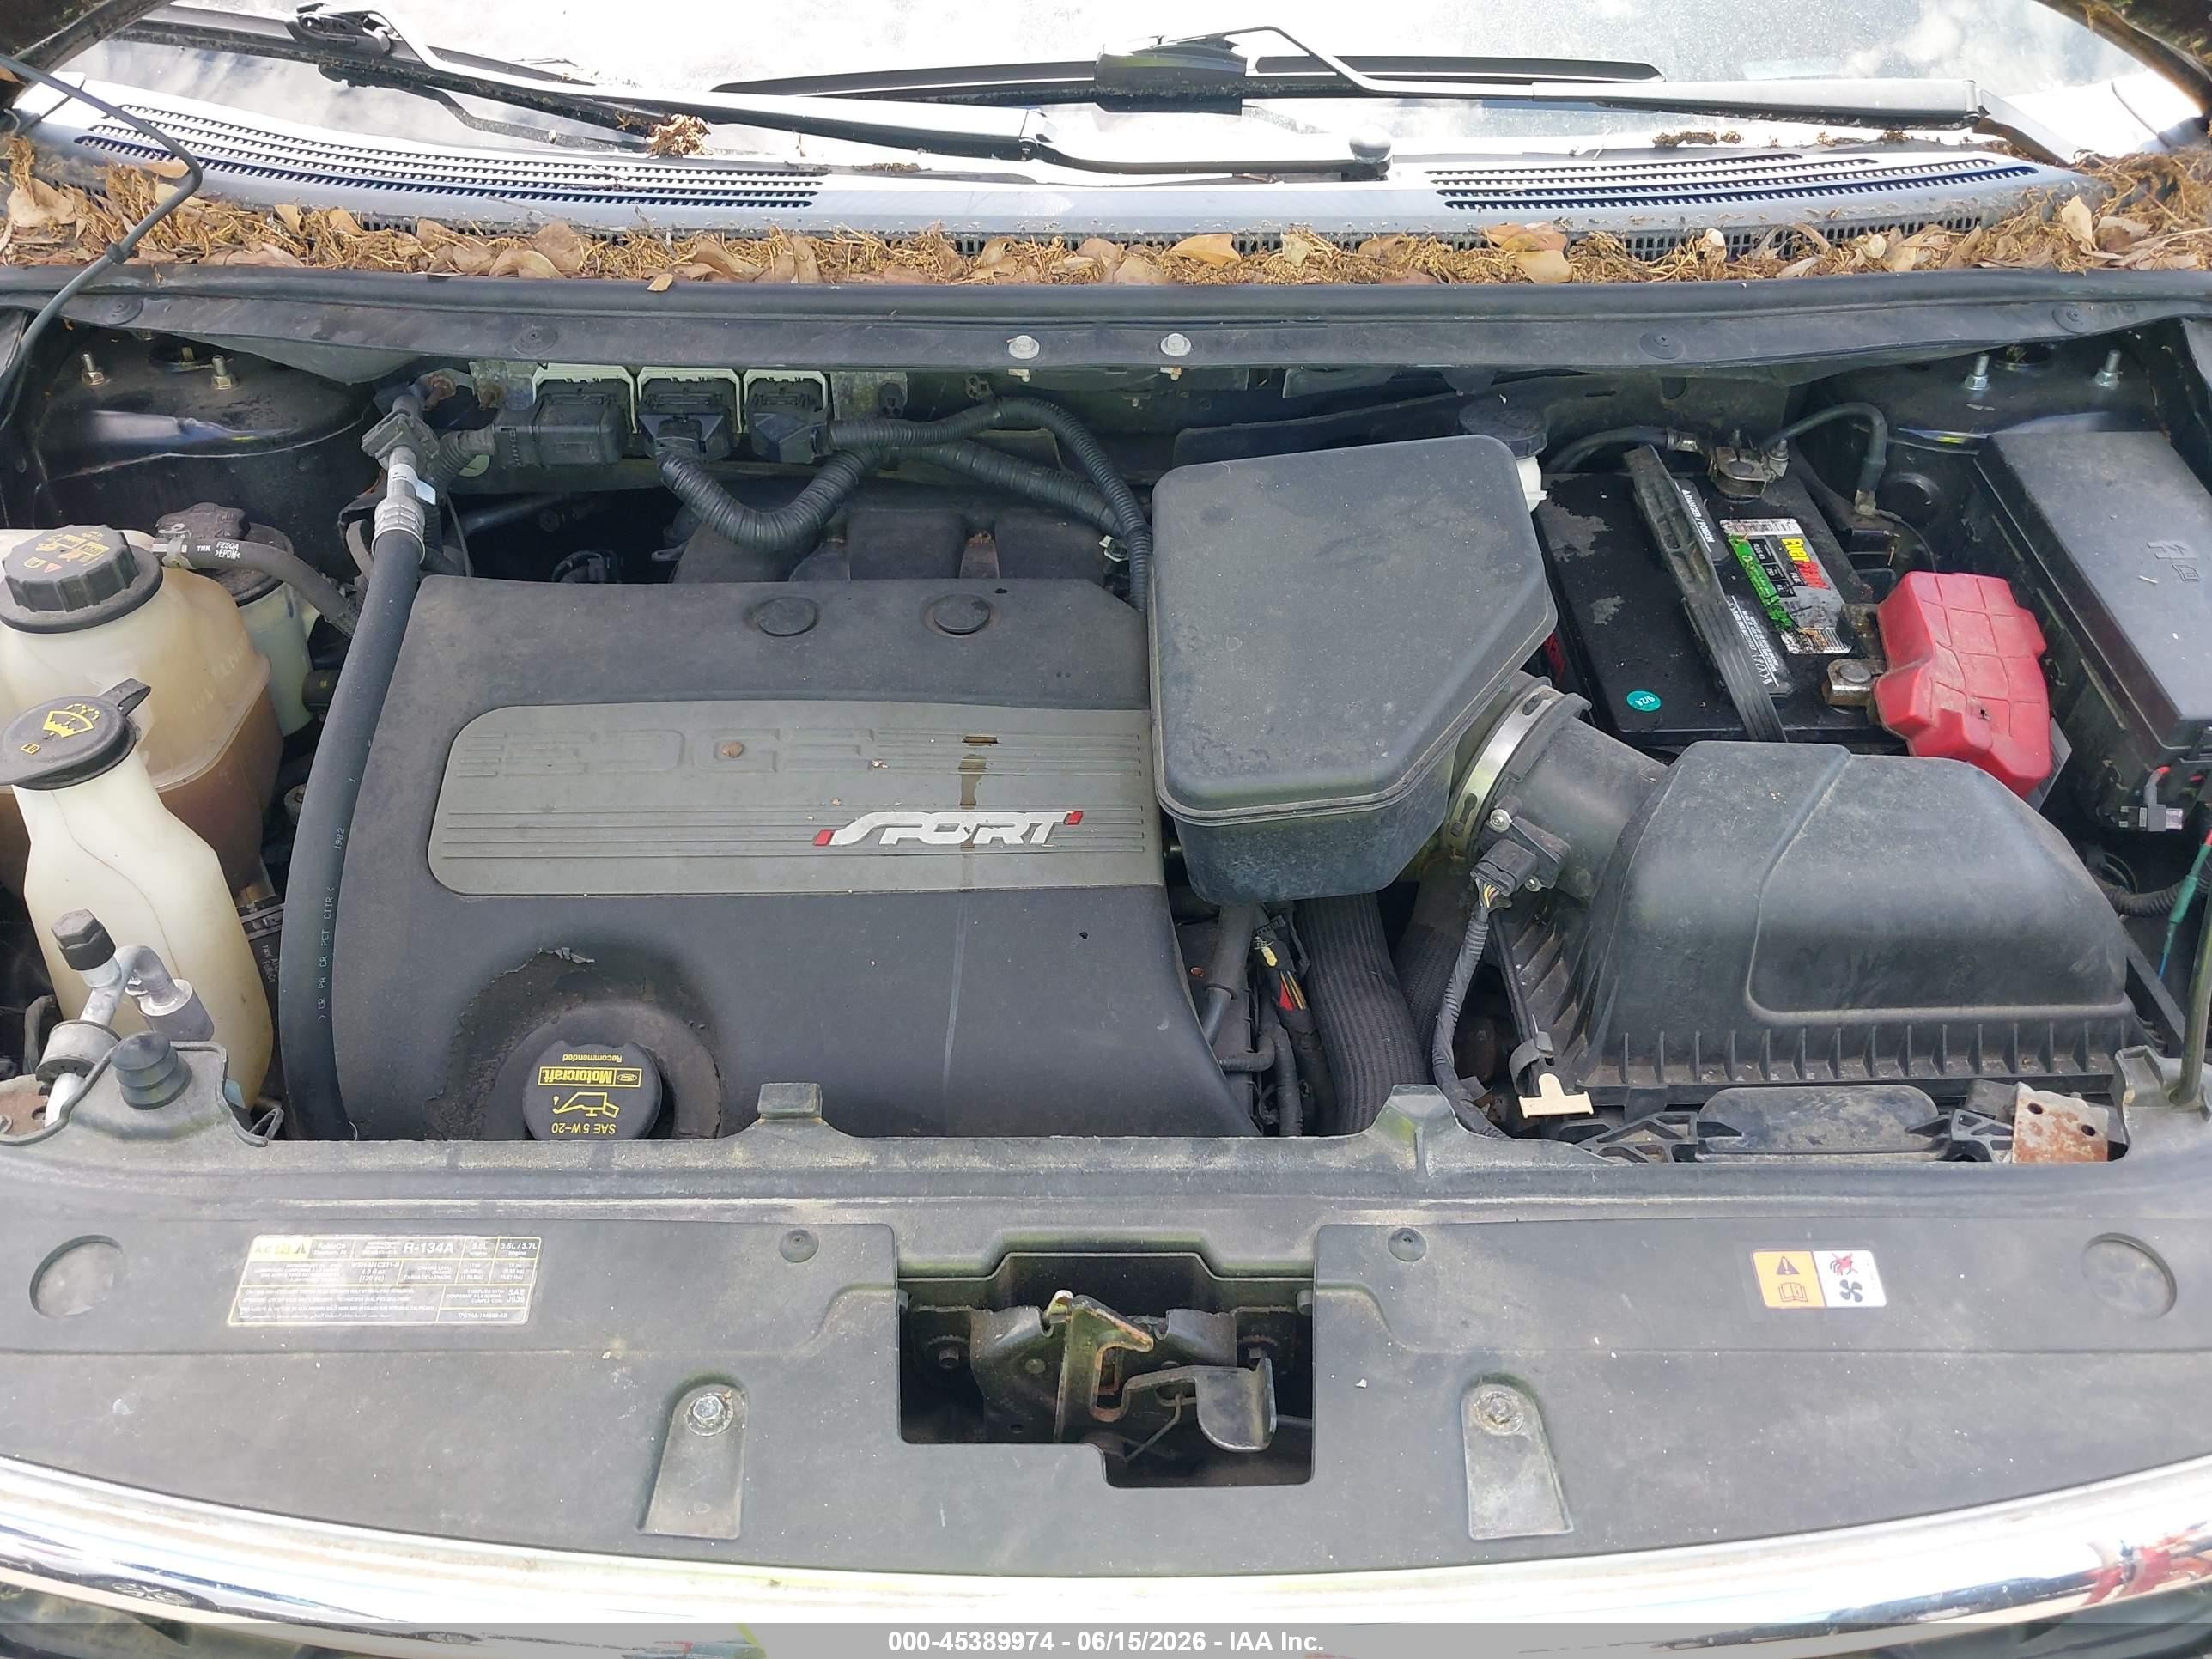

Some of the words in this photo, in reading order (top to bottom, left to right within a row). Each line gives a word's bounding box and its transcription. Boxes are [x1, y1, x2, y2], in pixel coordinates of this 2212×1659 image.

[1684, 495, 1702, 517] DANGER
[1697, 521, 1716, 543] POISON
[816, 810, 1083, 847] SPORT
[320, 928, 329, 946] PET
[562, 1053, 623, 1064] Recommended
[551, 1121, 591, 1134] 5W-20
[592, 1123, 617, 1135] SAE
[404, 1242, 454, 1254] R-134A
